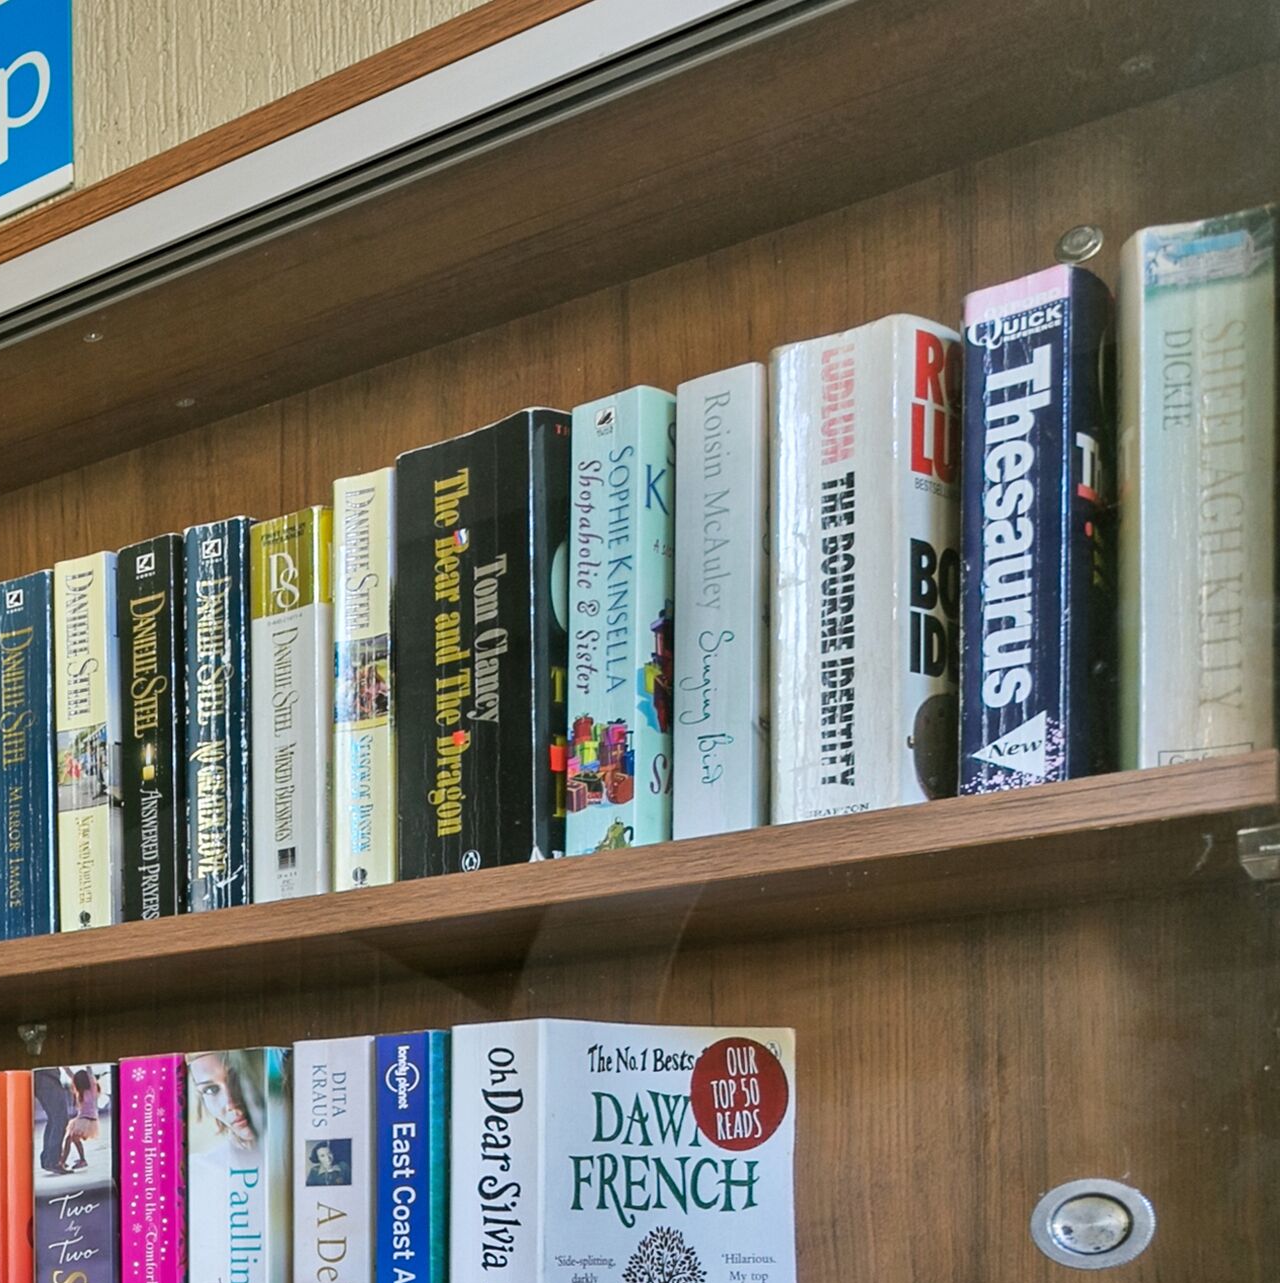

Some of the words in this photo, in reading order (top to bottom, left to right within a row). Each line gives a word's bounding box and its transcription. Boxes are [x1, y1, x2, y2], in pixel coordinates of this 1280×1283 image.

[966, 303, 1063, 350] QUICK
[432, 467, 469, 529] The
[605, 444, 635, 550] SOPHIE
[981, 343, 1052, 709] Thesaurus
[432, 528, 469, 603] Bear
[471, 552, 507, 624] Tom
[129, 590, 166, 677] DANIELLE
[433, 611, 471, 666] and
[604, 554, 633, 695] KINSELLA
[270, 626, 300, 693] DANIELLE
[466, 627, 509, 724] Clancy
[129, 675, 167, 739] STEEL
[270, 692, 300, 738] STEEL
[433, 667, 471, 727] The
[987, 736, 1043, 760] New
[427, 728, 472, 838] Dragon
[7, 786, 24, 852] MIRROR
[138, 787, 163, 861] ANSWERED
[8, 857, 24, 909] IMAGE
[137, 862, 160, 920] PRAYERS
[486, 1046, 516, 1087] Oh
[709, 1080, 739, 1108] TOP
[739, 1077, 761, 1106] 50
[725, 1046, 760, 1076] OUR
[390, 1121, 416, 1180] East
[480, 1086, 525, 1171] Dear
[715, 1109, 762, 1141] READS
[48, 1188, 102, 1220] Two
[390, 1184, 417, 1261] Coast
[477, 1169, 523, 1272] Silvia
[568, 1154, 761, 1229] FRENCH
[47, 1235, 100, 1266] Two
